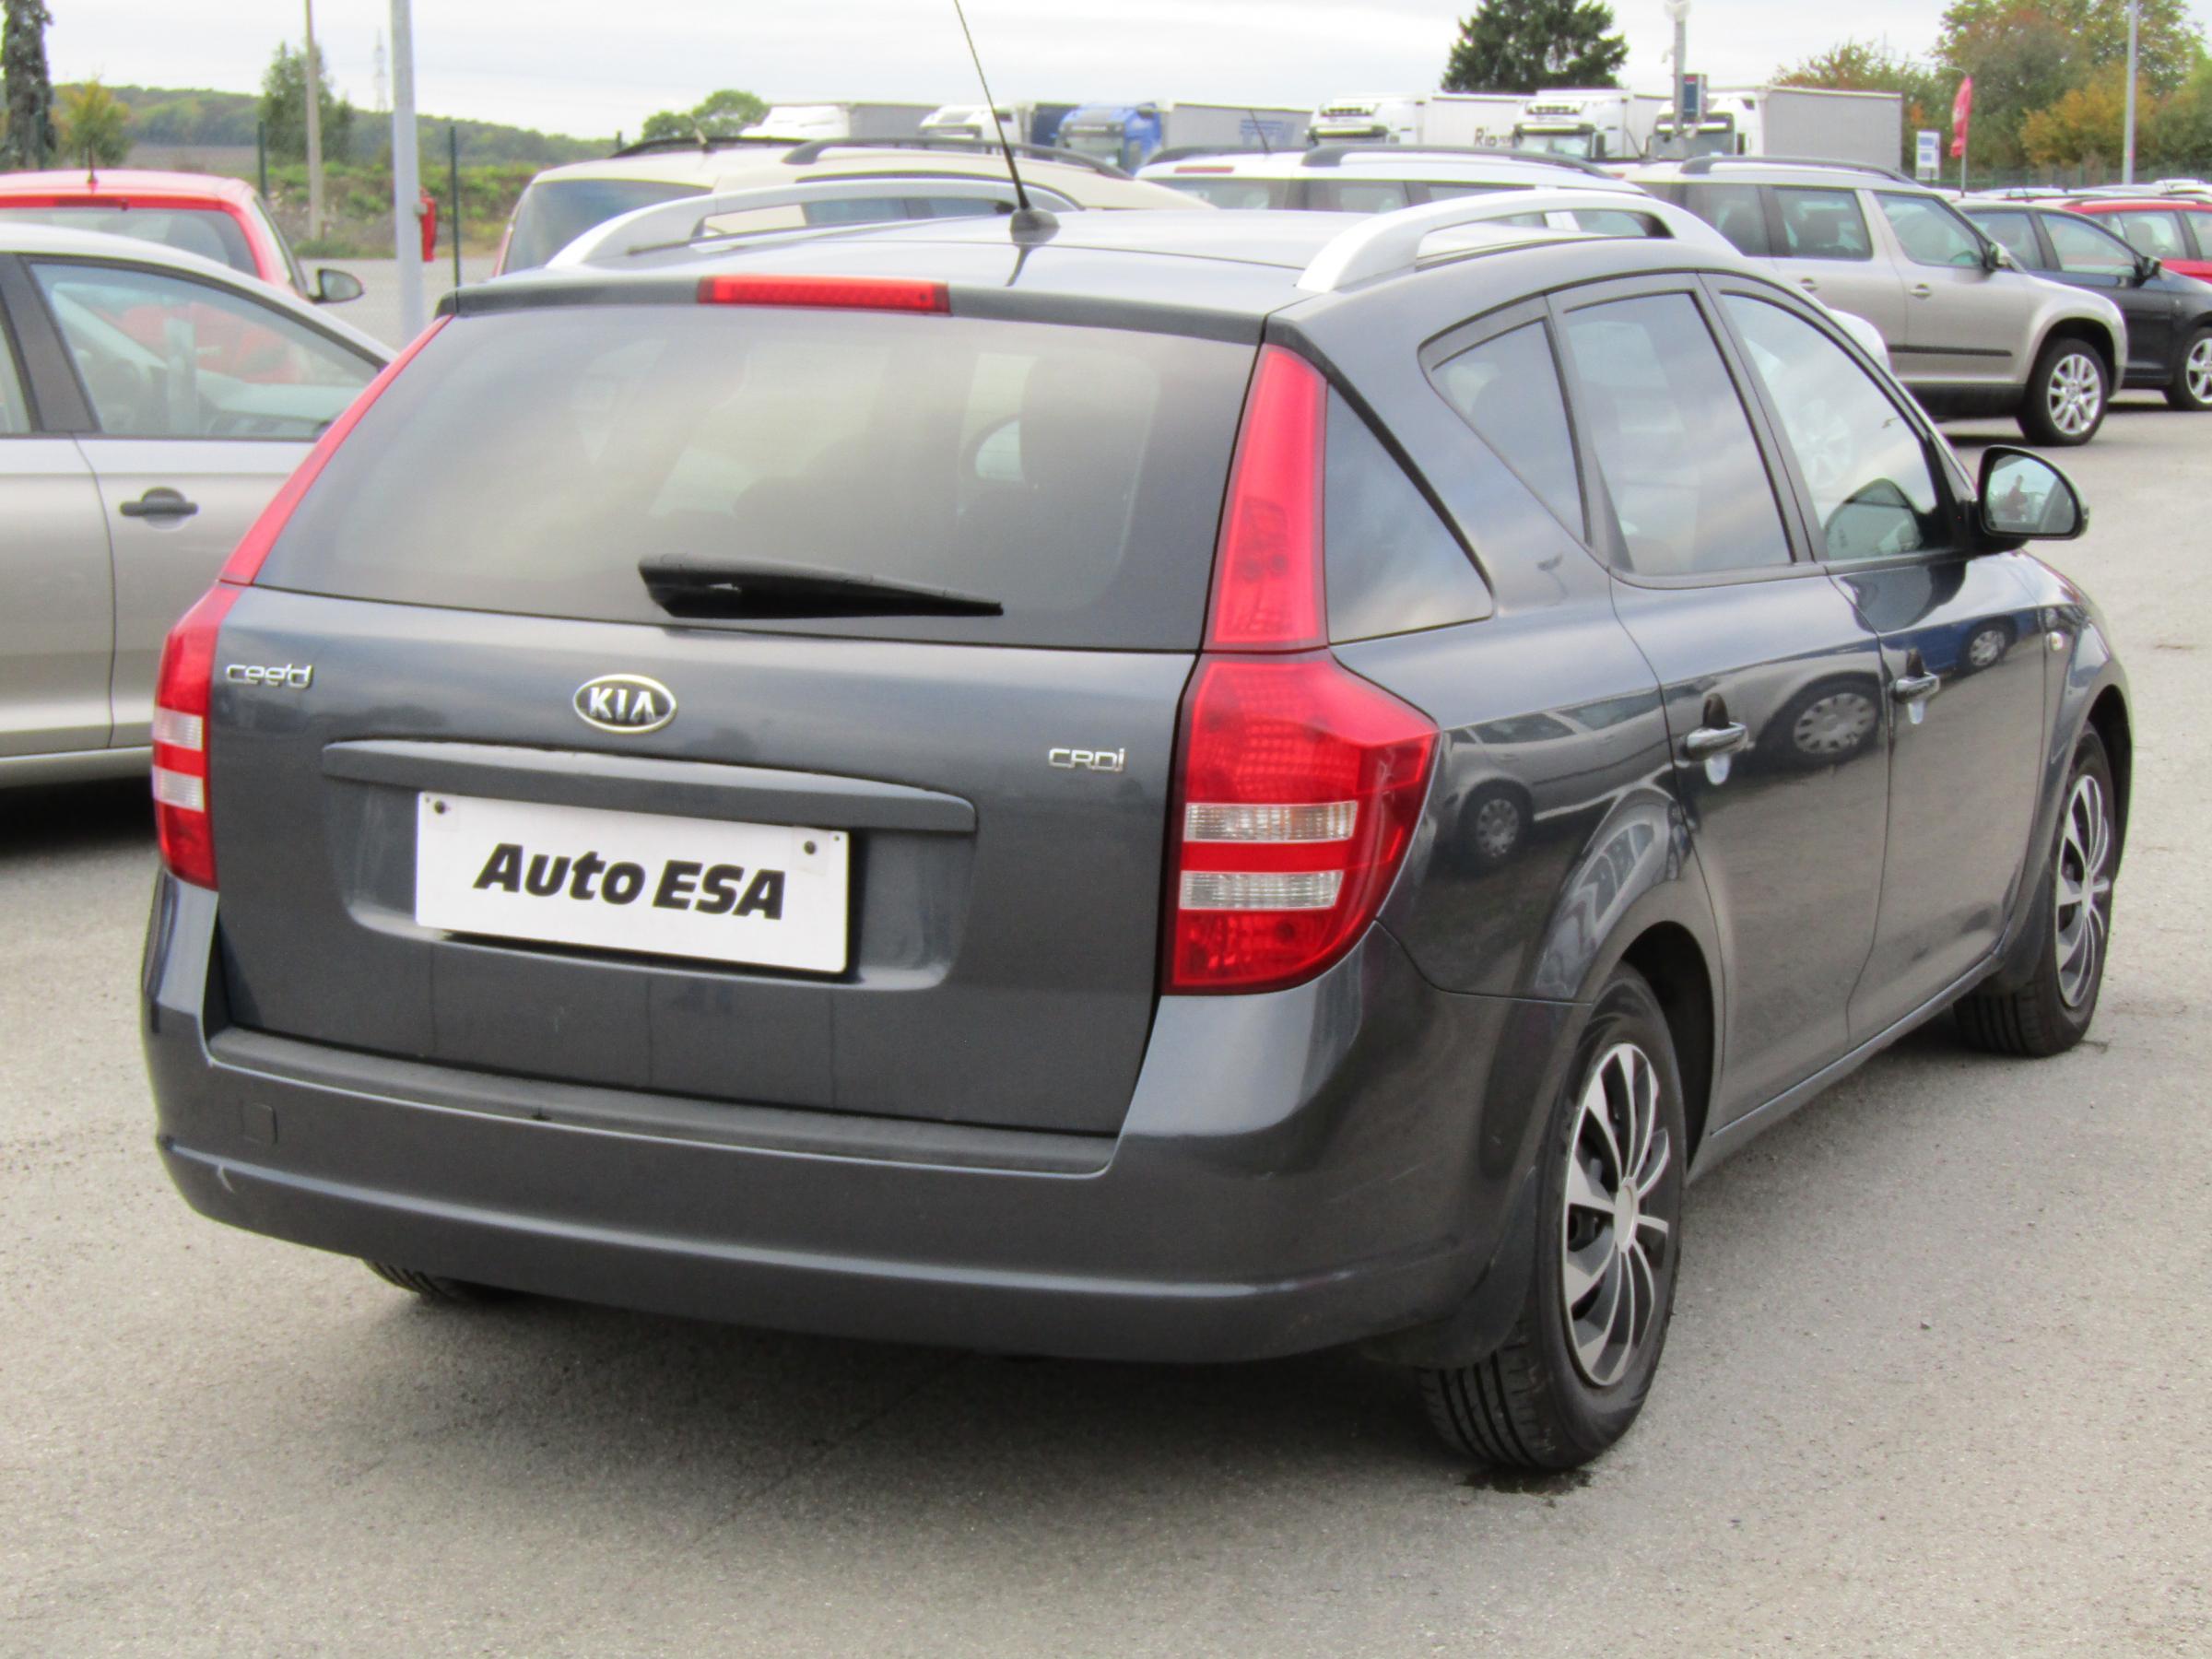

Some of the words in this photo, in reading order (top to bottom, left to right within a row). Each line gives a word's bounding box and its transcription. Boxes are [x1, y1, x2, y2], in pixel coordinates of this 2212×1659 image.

[589, 687, 656, 724] KIA
[472, 842, 645, 905] Auto
[653, 859, 786, 921] ESA
